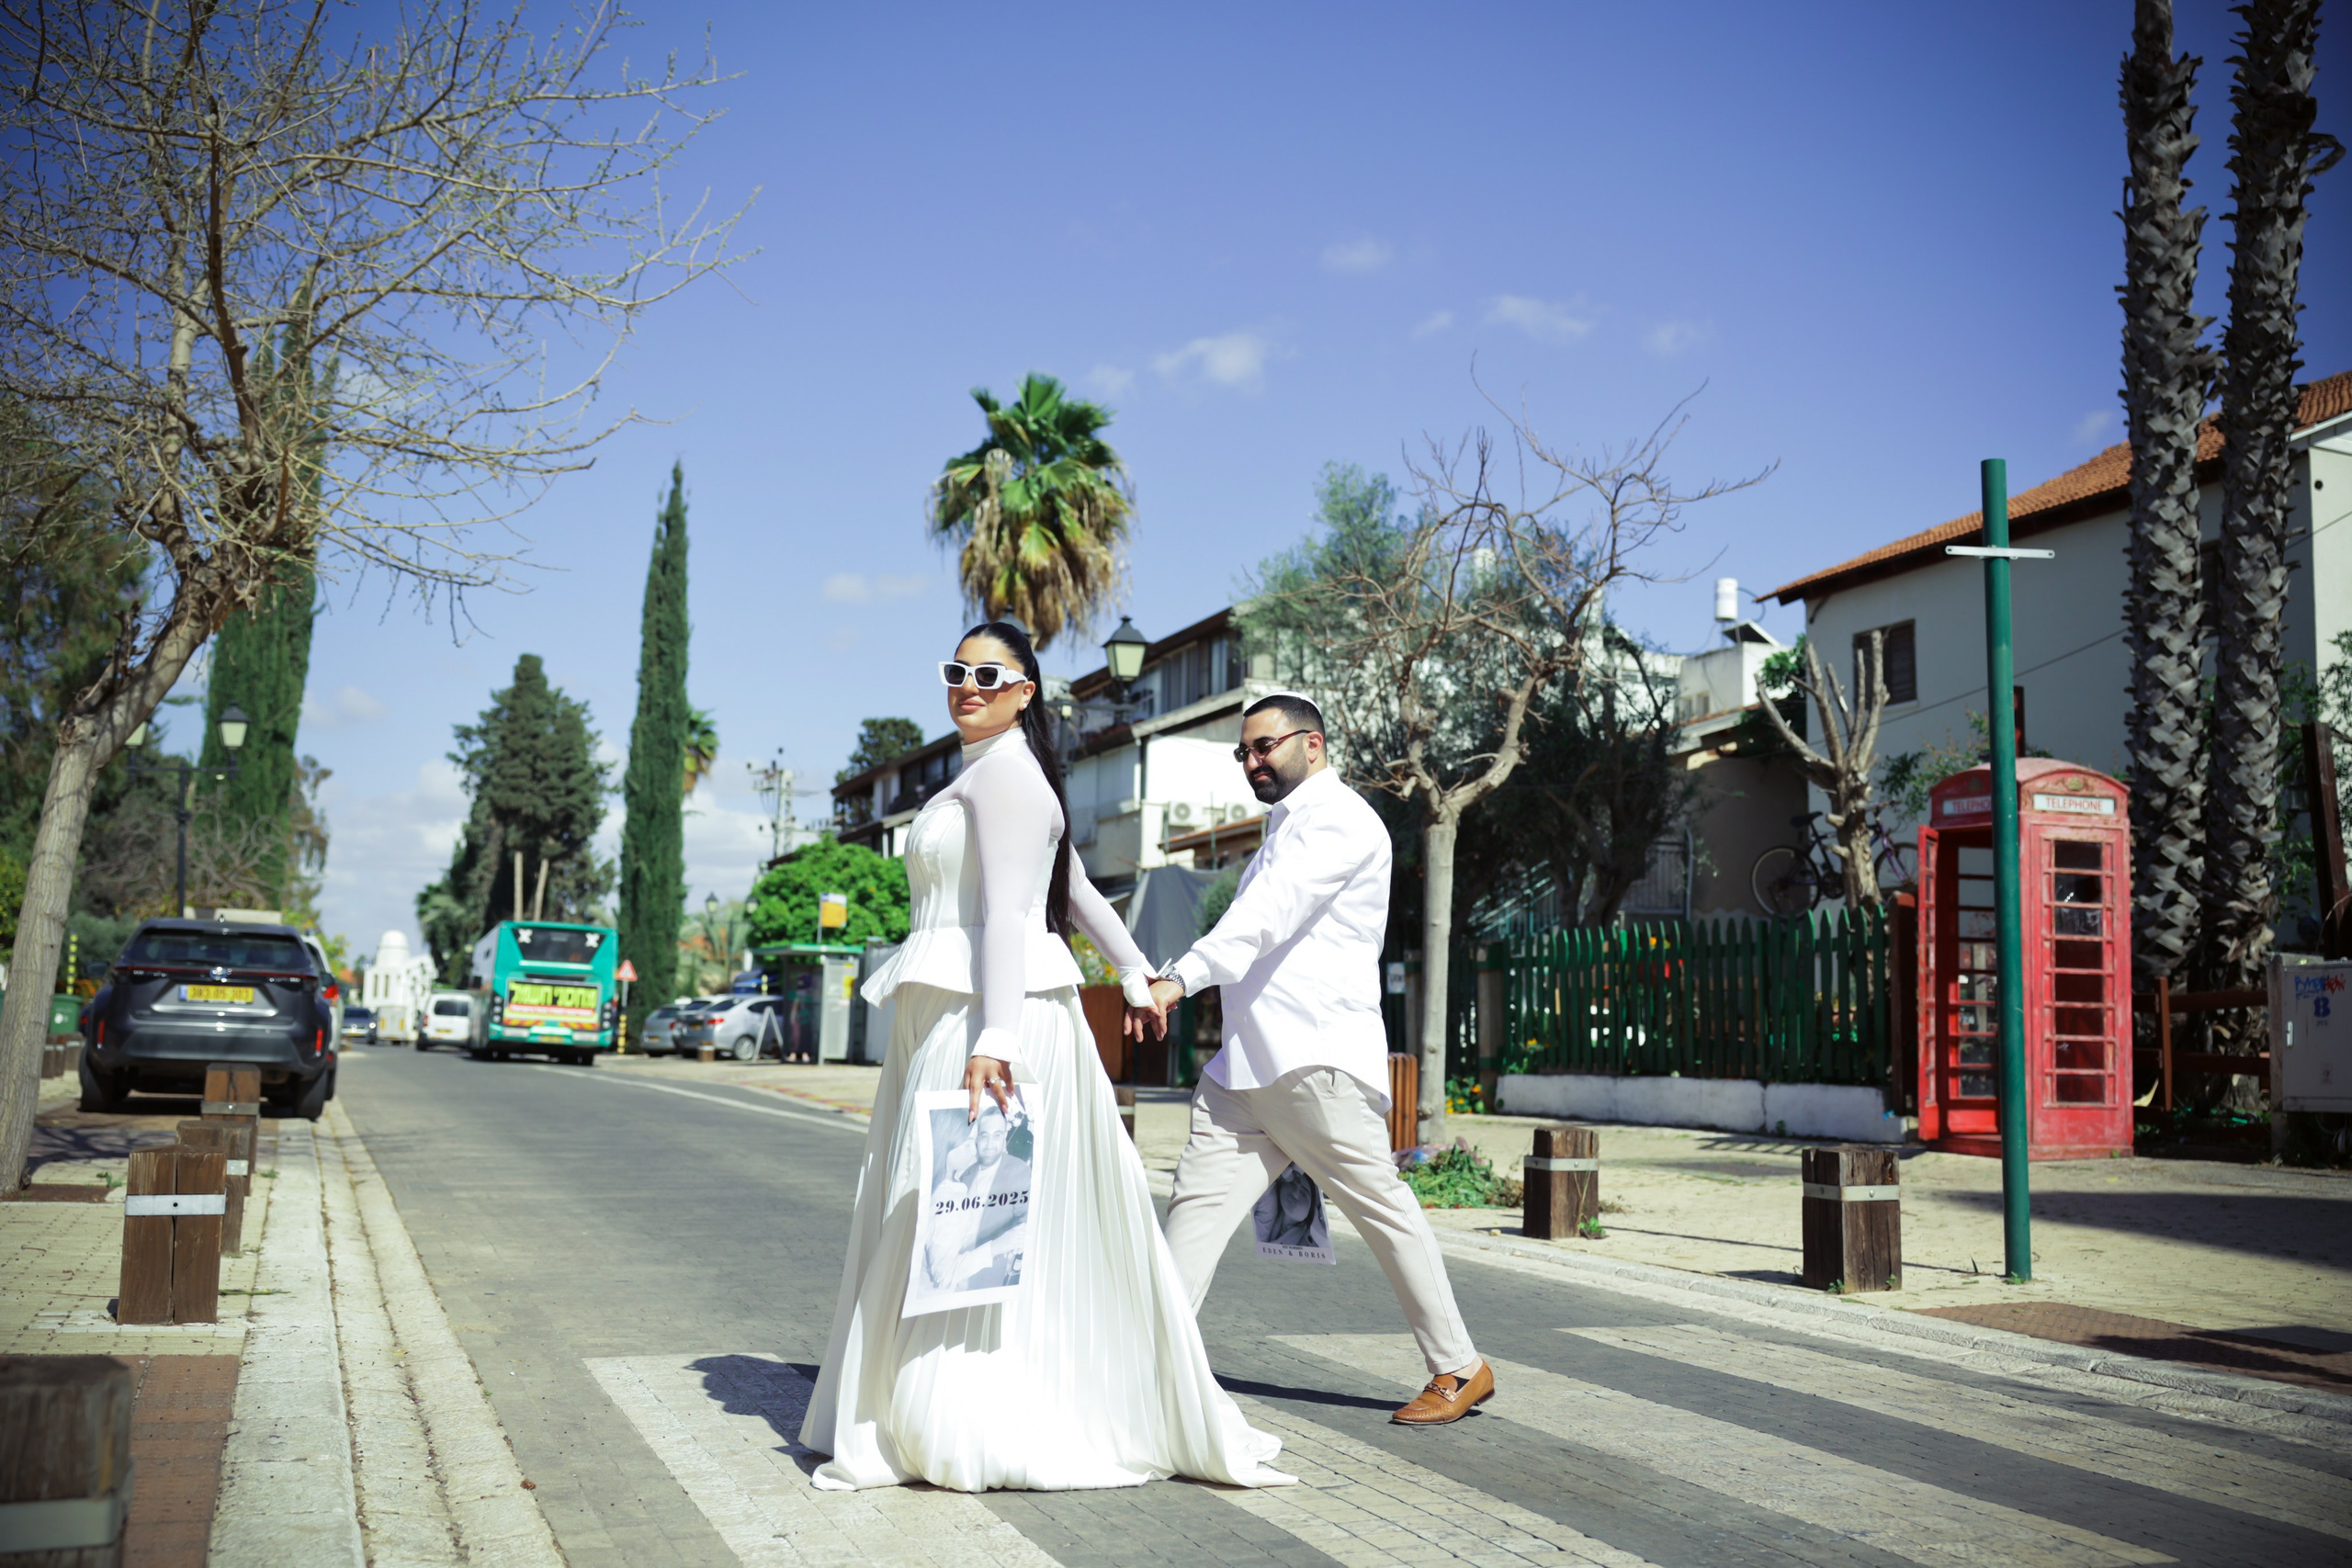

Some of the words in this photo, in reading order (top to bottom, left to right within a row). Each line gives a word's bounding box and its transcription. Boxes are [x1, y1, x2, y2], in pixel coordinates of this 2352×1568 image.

[1952, 799, 1991, 813] TELEPHO
[2045, 796, 2103, 811] TELEPHONE
[935, 1190, 1029, 1215] 29.06.2025
[1262, 1247, 1283, 1255] EDEN
[1298, 1250, 1326, 1259] BORIS
